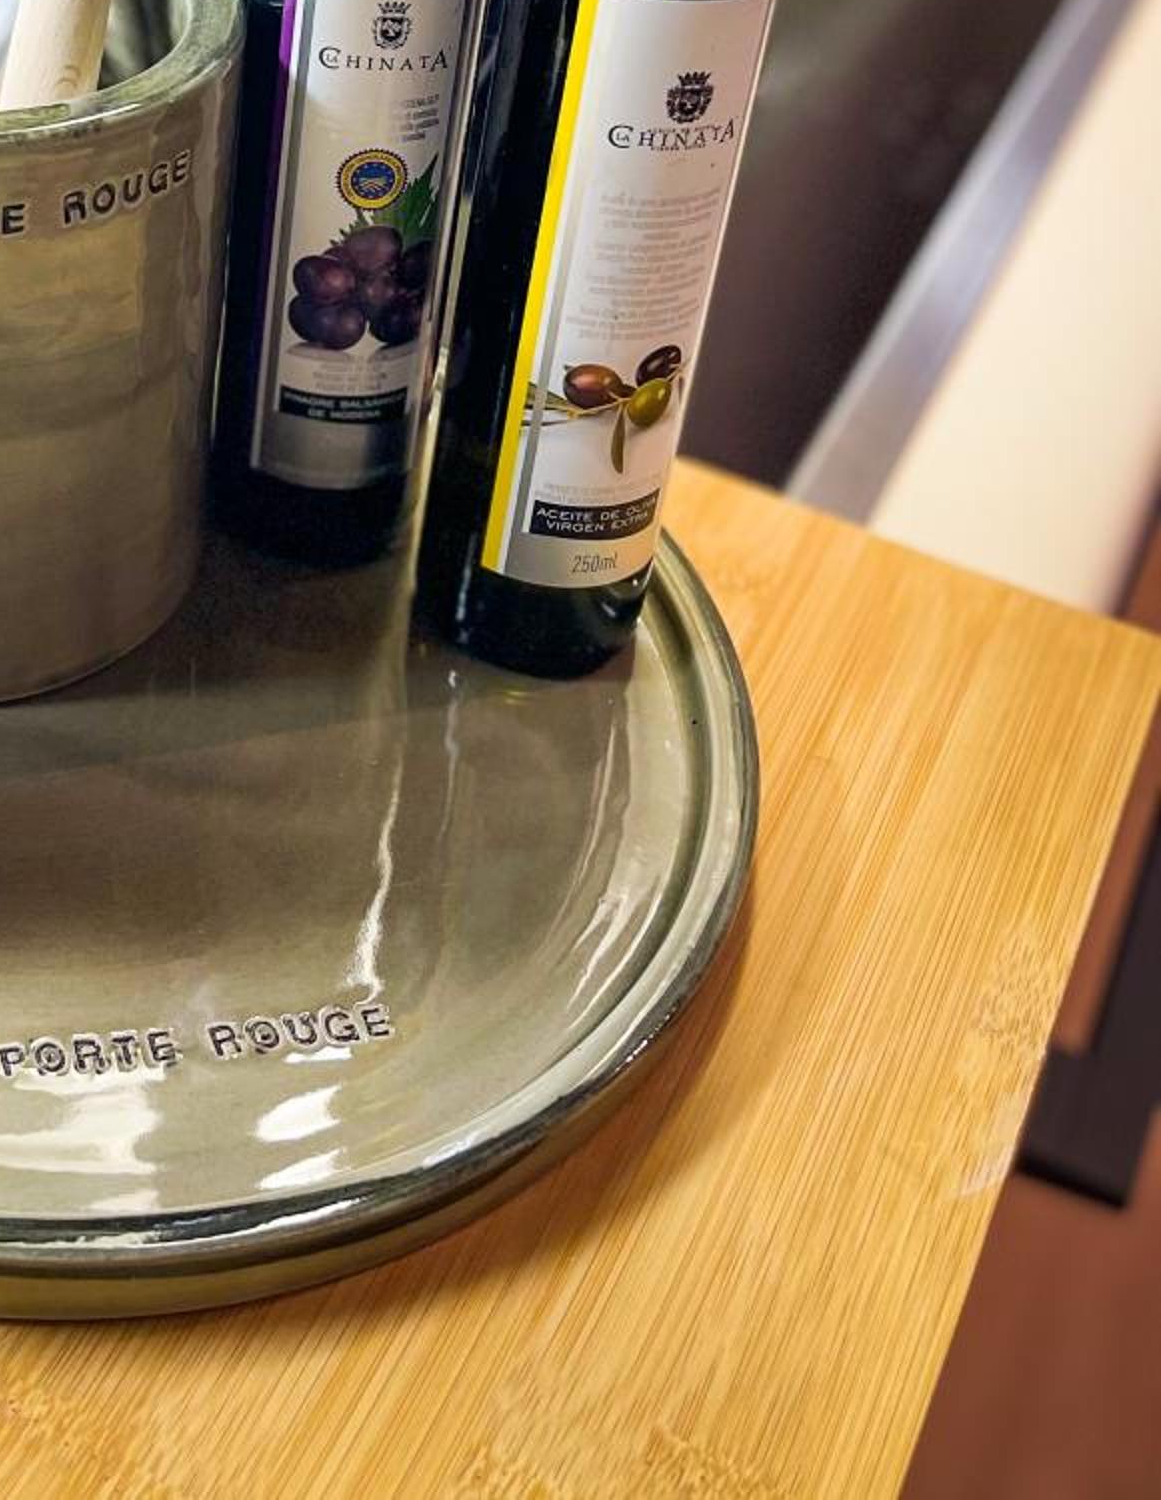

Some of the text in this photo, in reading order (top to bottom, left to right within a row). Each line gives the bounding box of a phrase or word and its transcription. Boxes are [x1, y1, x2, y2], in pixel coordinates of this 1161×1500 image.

[319, 46, 448, 72] CHINATA
[608, 118, 735, 149] CHINATA
[62, 149, 192, 228] ROUGE
[536, 507, 594, 522] ACEITE
[600, 510, 621, 521] DE
[545, 520, 605, 533] VIRGEN
[572, 551, 619, 573] 250ml
[0, 1029, 178, 1078] PORTE
[207, 1004, 392, 1059] ROUGE
